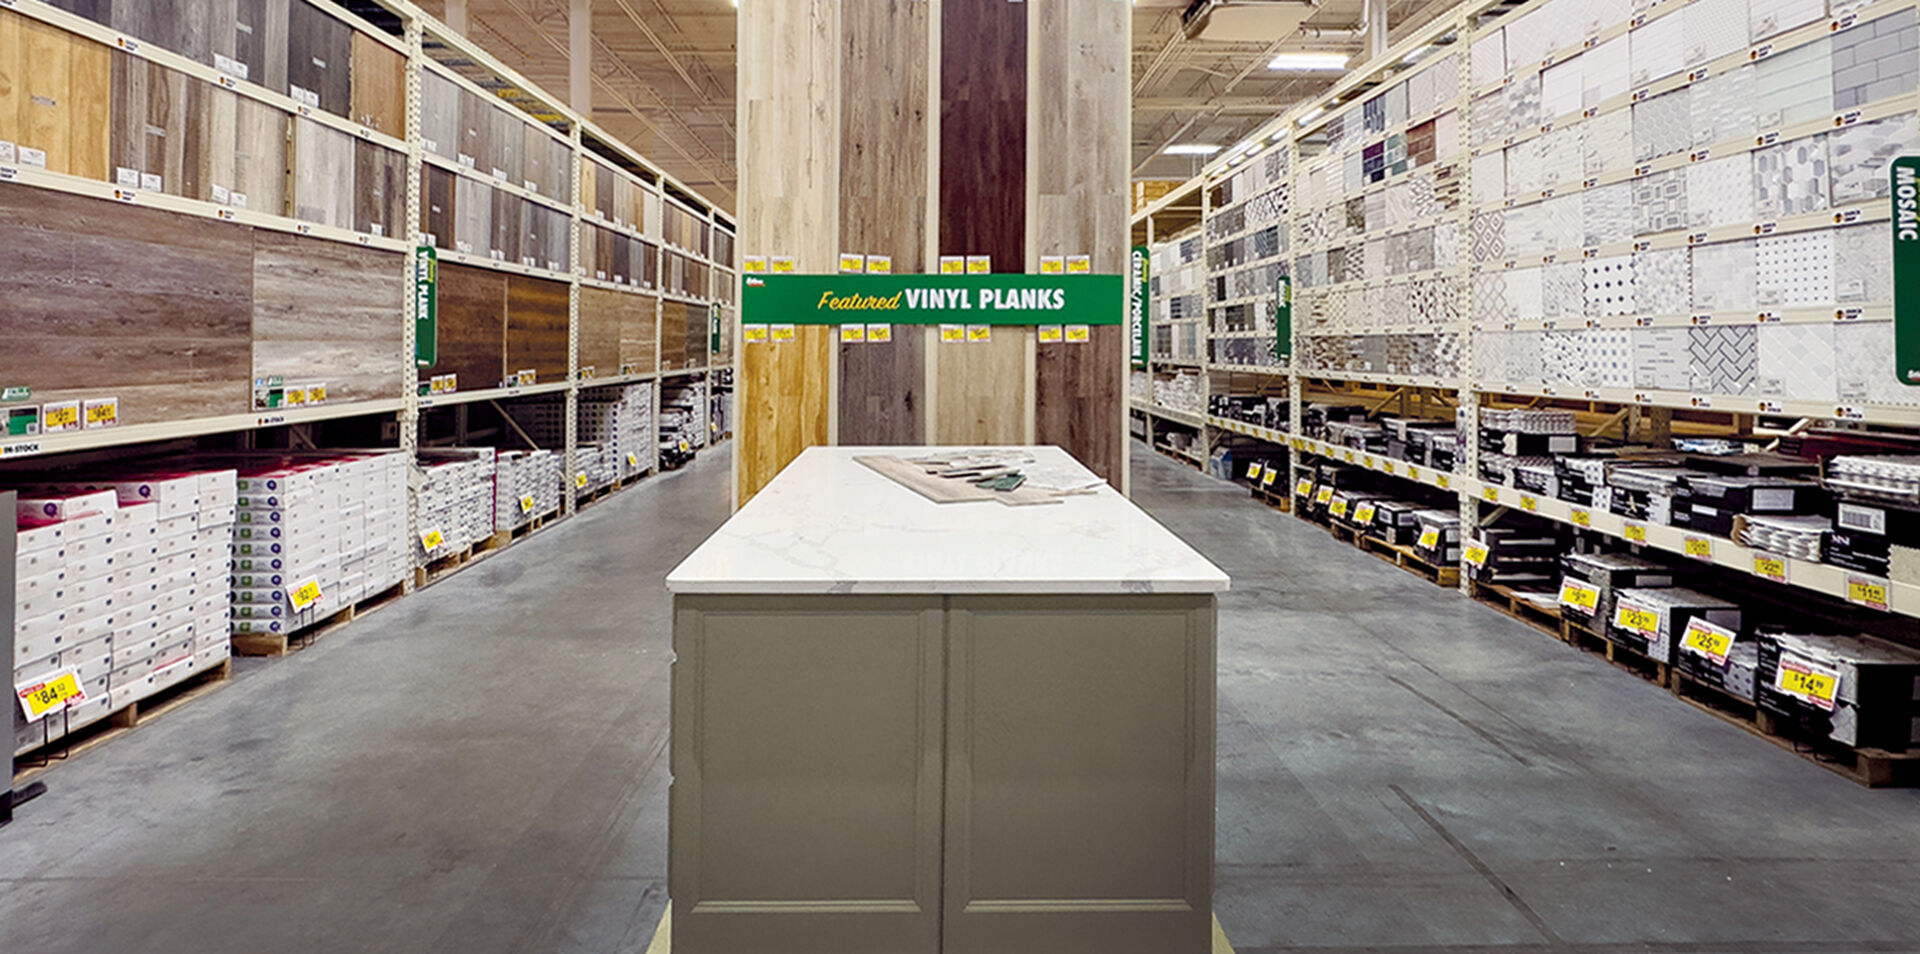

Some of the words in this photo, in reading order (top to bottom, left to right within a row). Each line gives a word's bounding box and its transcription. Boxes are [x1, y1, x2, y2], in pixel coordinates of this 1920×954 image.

[1896, 166, 1919, 241] MOSAIC
[418, 251, 429, 282] VINYL
[418, 284, 429, 320] PLANK
[817, 291, 902, 310] Featured
[905, 288, 972, 310] VINYL
[979, 288, 1065, 310] PLANKS
